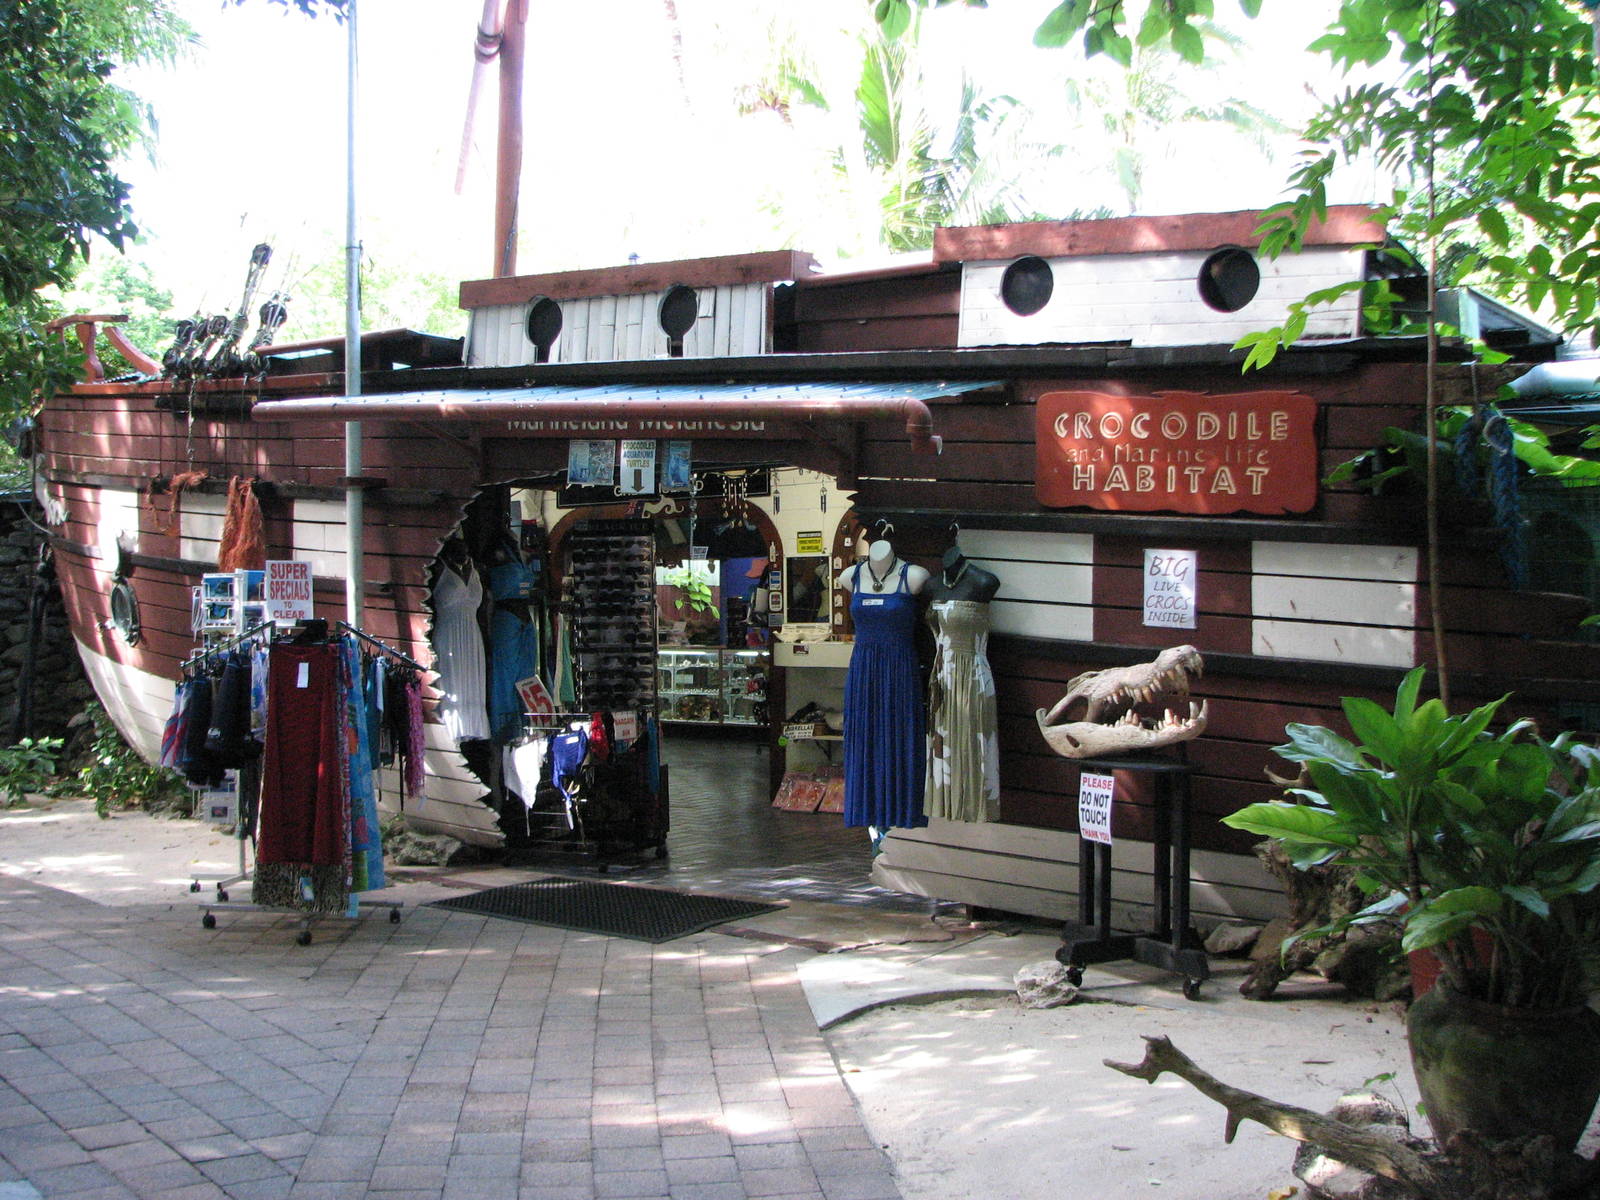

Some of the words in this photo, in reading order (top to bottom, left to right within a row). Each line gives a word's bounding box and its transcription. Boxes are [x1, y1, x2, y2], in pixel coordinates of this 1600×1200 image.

[1054, 411, 1289, 441] CROCODILE
[1066, 445, 1104, 464] and
[1113, 443, 1205, 464] Marine
[1072, 464, 1270, 495] HABITAT
[270, 563, 308, 580] SUPER
[1149, 555, 1189, 581] BIG
[269, 580, 310, 601] SPECIALS
[1153, 581, 1182, 593] LIVE
[283, 601, 293, 609] TO
[1145, 594, 1192, 611] CROCS
[272, 610, 305, 619] CLEAR
[1147, 611, 1188, 624] INSIDE
[1082, 776, 1113, 791] PLEASE
[1081, 791, 1092, 806] DO
[1093, 792, 1110, 809] NOT
[1080, 807, 1107, 827] TOUCH
[1081, 828, 1098, 839] THANK
[1098, 832, 1110, 842] YOU
